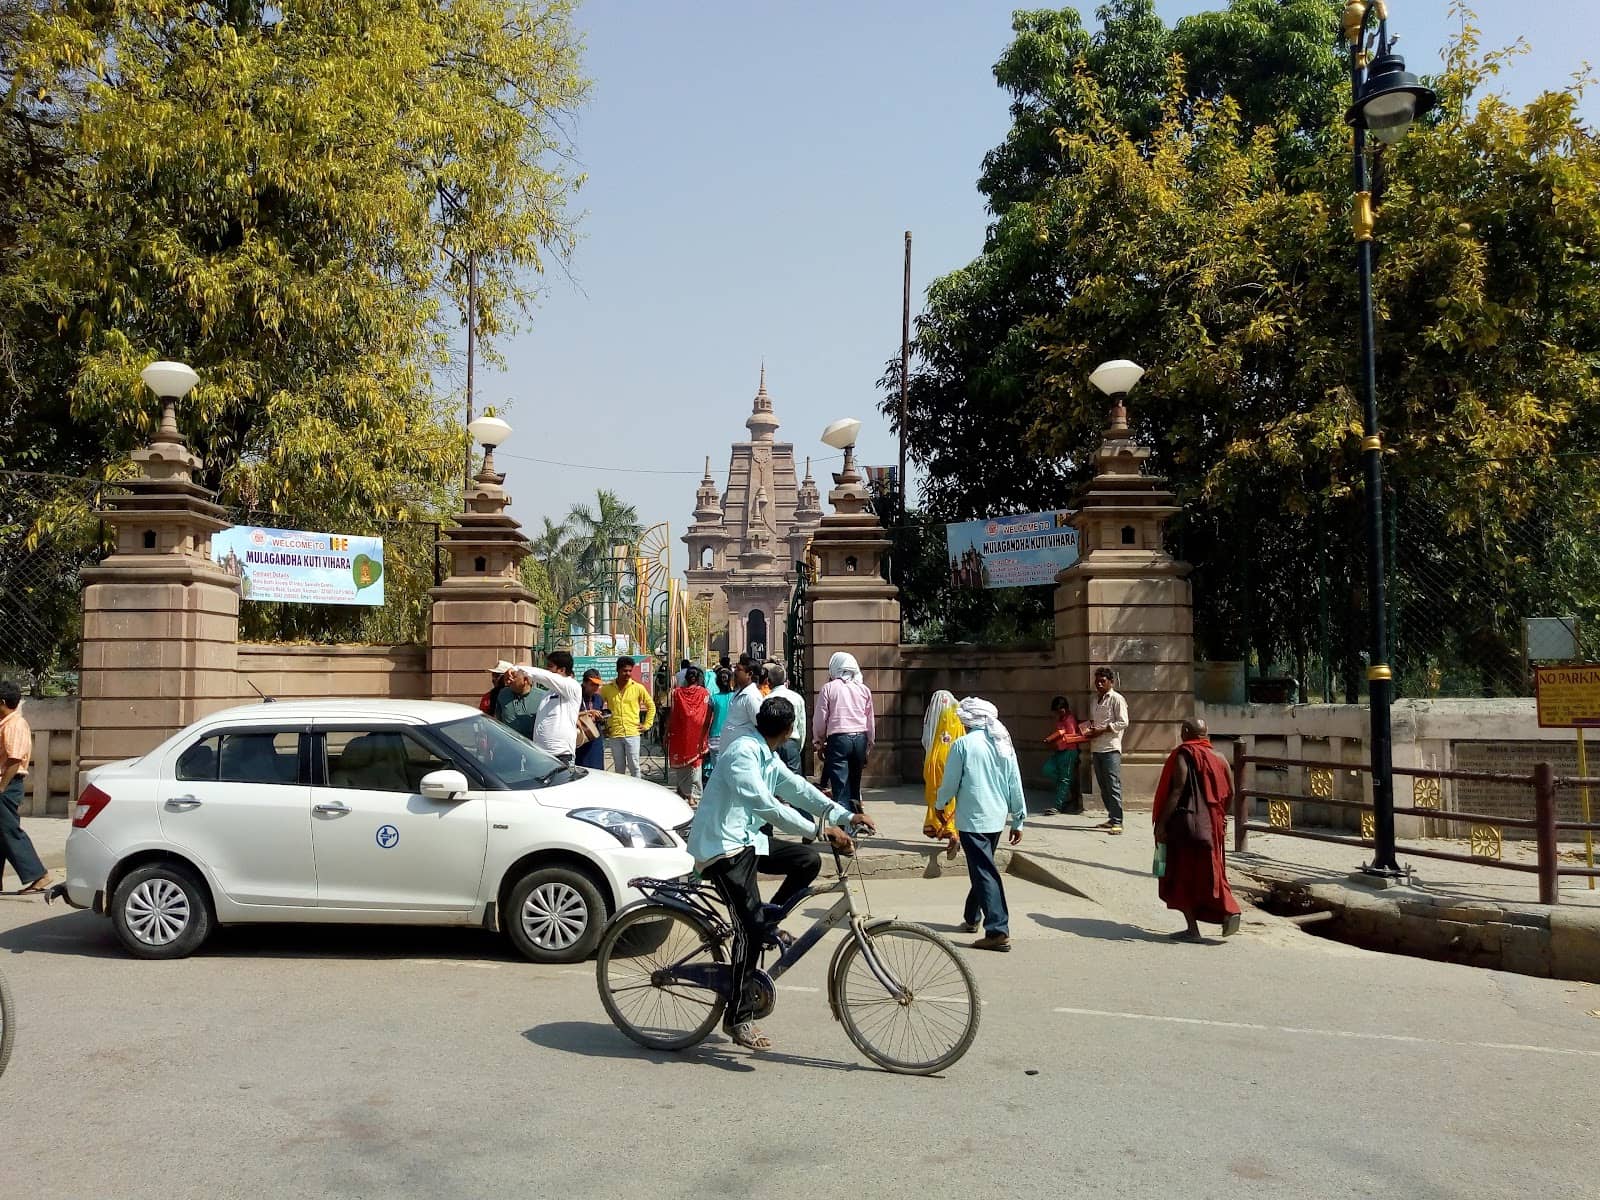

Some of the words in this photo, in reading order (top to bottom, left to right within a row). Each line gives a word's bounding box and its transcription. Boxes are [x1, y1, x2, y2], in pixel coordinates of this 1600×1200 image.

[1003, 522, 1038, 533] WELCOME
[1040, 521, 1050, 530] TO
[272, 538, 313, 550] WELCOME
[314, 542, 325, 550] TO
[984, 539, 1030, 554] MULAGANDHA
[1031, 536, 1046, 549] KUTI
[1048, 533, 1075, 547] VIHARA
[246, 550, 302, 567] MULAGANDHA
[303, 555, 321, 569] KUTI
[322, 556, 351, 570] VIHARA
[1539, 672, 1556, 685] NO
